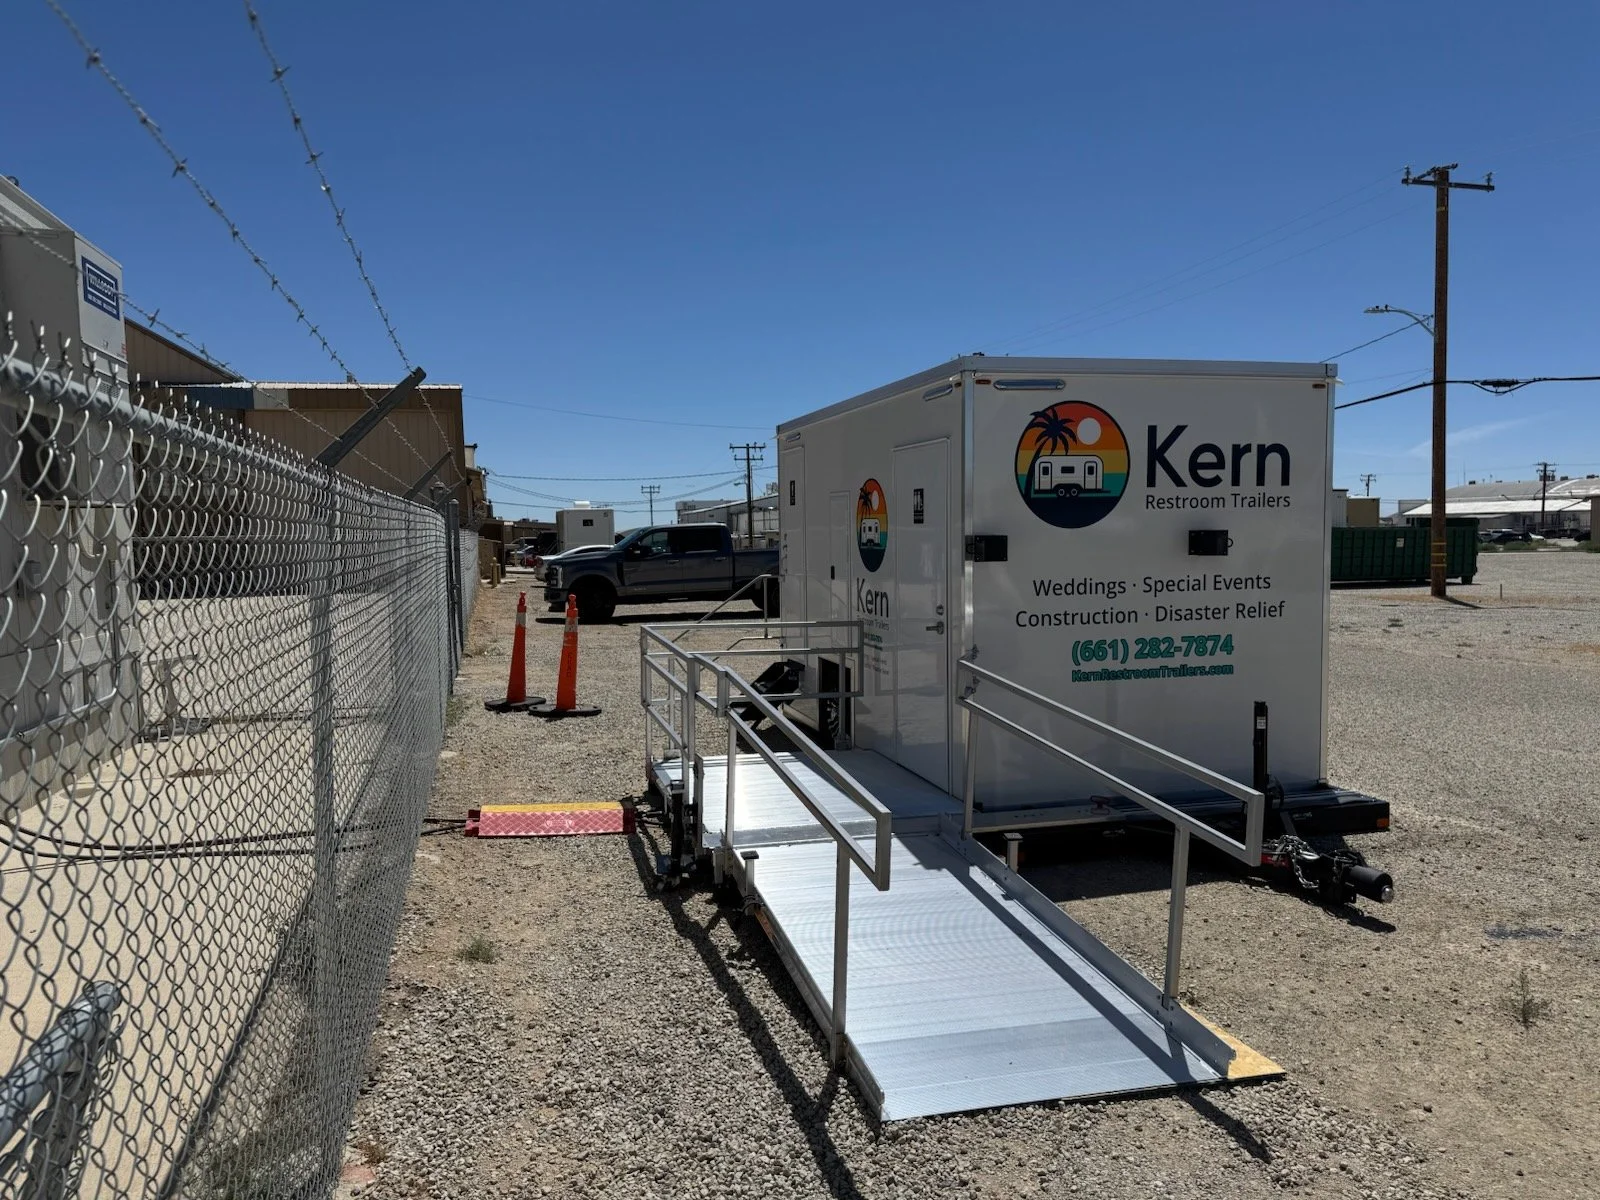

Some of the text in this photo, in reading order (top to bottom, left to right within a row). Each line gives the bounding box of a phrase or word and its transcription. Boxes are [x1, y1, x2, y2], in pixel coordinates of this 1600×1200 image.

[1147, 425, 1291, 488] Kern
[1146, 492, 1291, 510] Restroom Trailers
[856, 578, 889, 618] Kern
[1033, 574, 1271, 599] Weddings Special Events
[1015, 601, 1286, 628] Construction Disaster Relief
[1071, 634, 1234, 665] (661) 282-7874
[1071, 664, 1234, 682] KernRestroomTrailers.com
